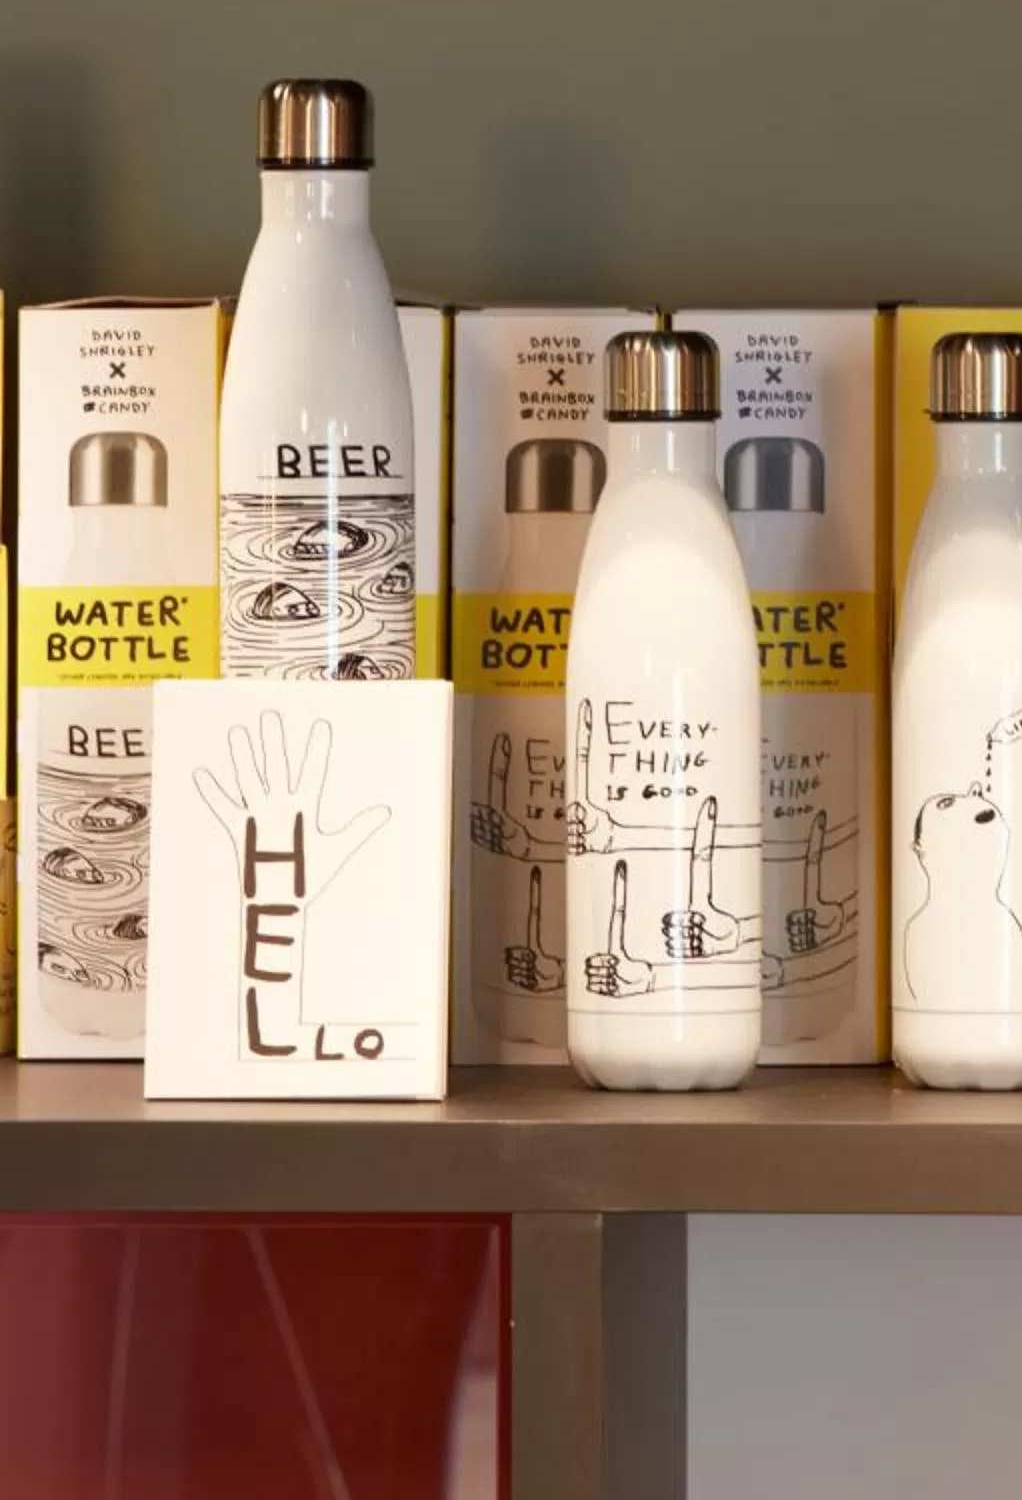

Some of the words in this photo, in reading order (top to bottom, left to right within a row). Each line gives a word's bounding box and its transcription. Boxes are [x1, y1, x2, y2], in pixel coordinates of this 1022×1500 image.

[92, 329, 142, 341] DAVID
[530, 336, 581, 348] DAVID
[747, 334, 799, 347] DAVID
[80, 345, 155, 358] SHRIGLEY
[517, 352, 595, 364] SHRIGLEY
[735, 350, 813, 364] SHRIGLEY
[81, 385, 156, 398] BRAINBOX
[519, 391, 595, 405] BRAINBOX
[736, 389, 813, 404] BRAINBOX
[277, 443, 391, 478] BEER
[491, 607, 571, 635] WAT
[752, 599, 845, 633] TER
[47, 632, 191, 663] BOTTLE
[482, 639, 568, 670] BOT
[757, 641, 848, 669] TTLE
[605, 700, 718, 745] EVERY-
[68, 724, 146, 758] BEE
[609, 749, 712, 776] THING
[765, 746, 832, 772] VERY-
[607, 784, 629, 801] IS
[766, 775, 821, 800] HING
